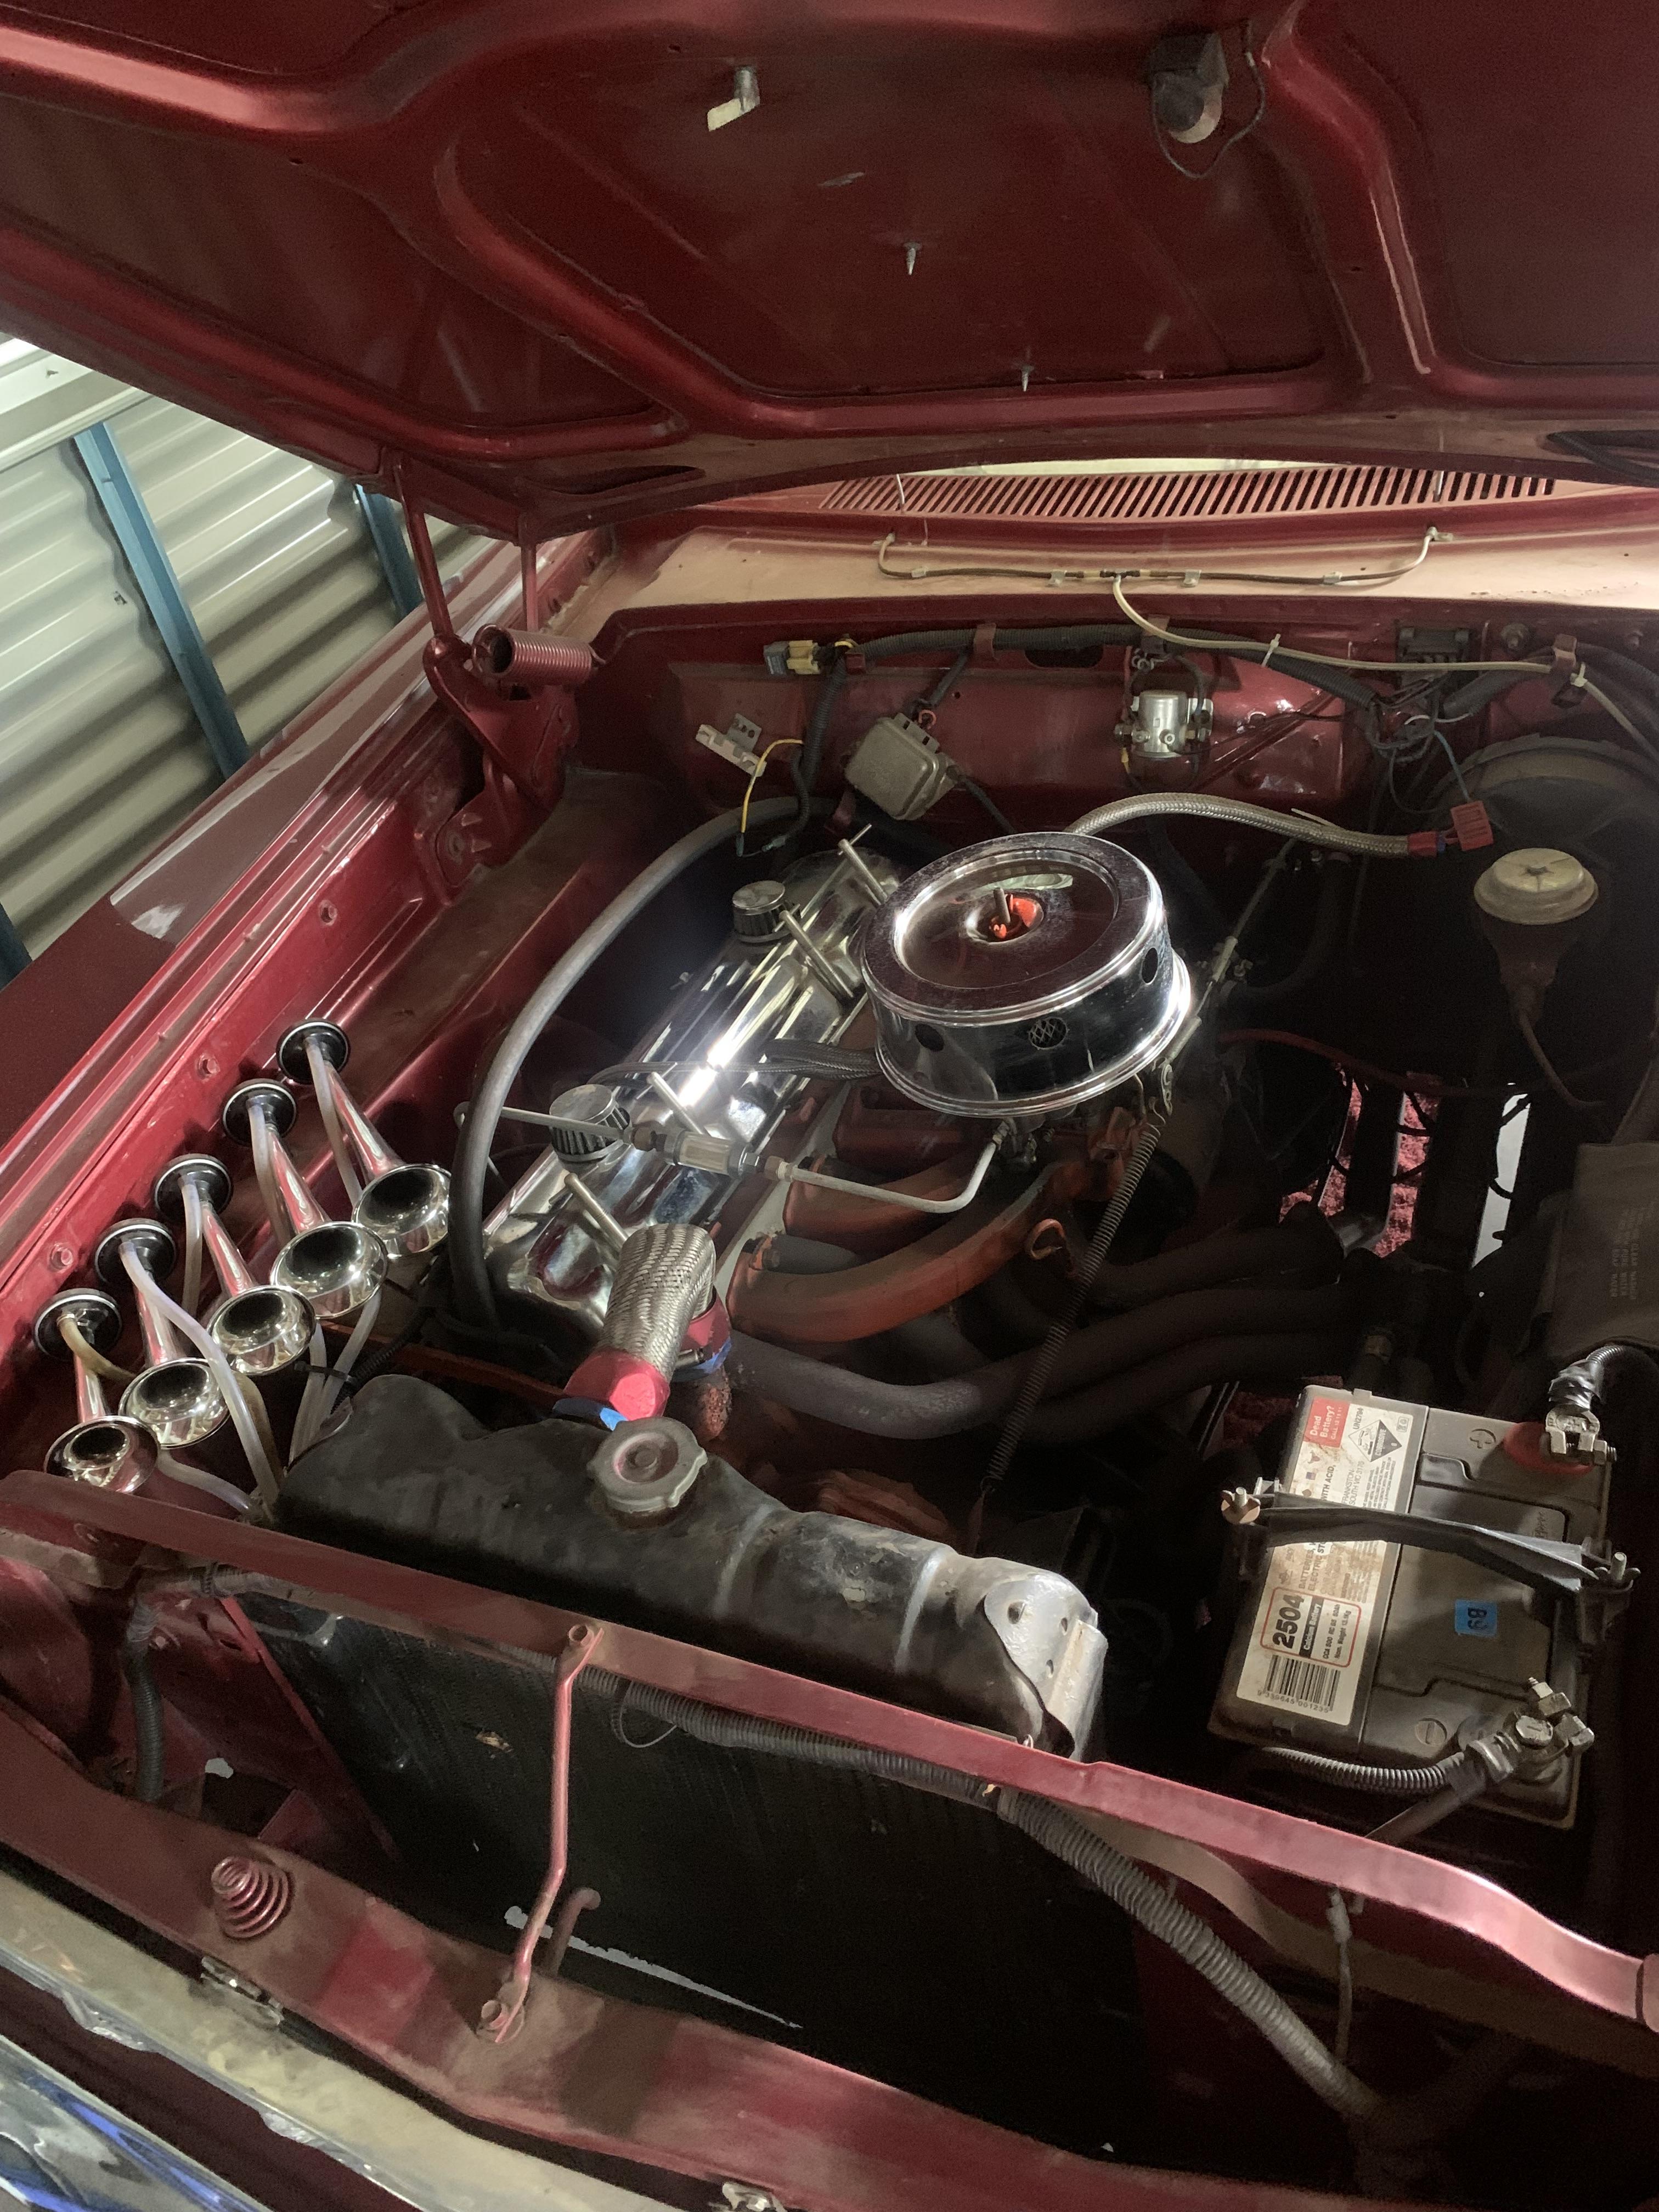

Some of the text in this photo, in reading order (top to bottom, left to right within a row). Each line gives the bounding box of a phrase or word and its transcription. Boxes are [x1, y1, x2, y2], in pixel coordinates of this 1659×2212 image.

[1310, 1415, 1322, 1436] Dead
[1320, 1405, 1335, 1438] Battery?
[1353, 1408, 1364, 1430] UN2794
[1374, 1428, 1387, 1456] CORROSIVE
[1325, 1464, 1336, 1483] ACID,
[1341, 1470, 1355, 1504] FRANKSTON-
[1348, 1485, 1358, 1505] SOUTH
[1299, 1549, 1316, 1589] BATTERIES,
[1308, 1555, 1322, 1591] ELECTRIC
[1272, 1594, 1305, 1649] 2504
[1303, 1603, 1322, 1650] Calcium Battery
[1338, 1628, 1347, 1644] Weight
[1298, 1701, 1329, 1713] 001235
